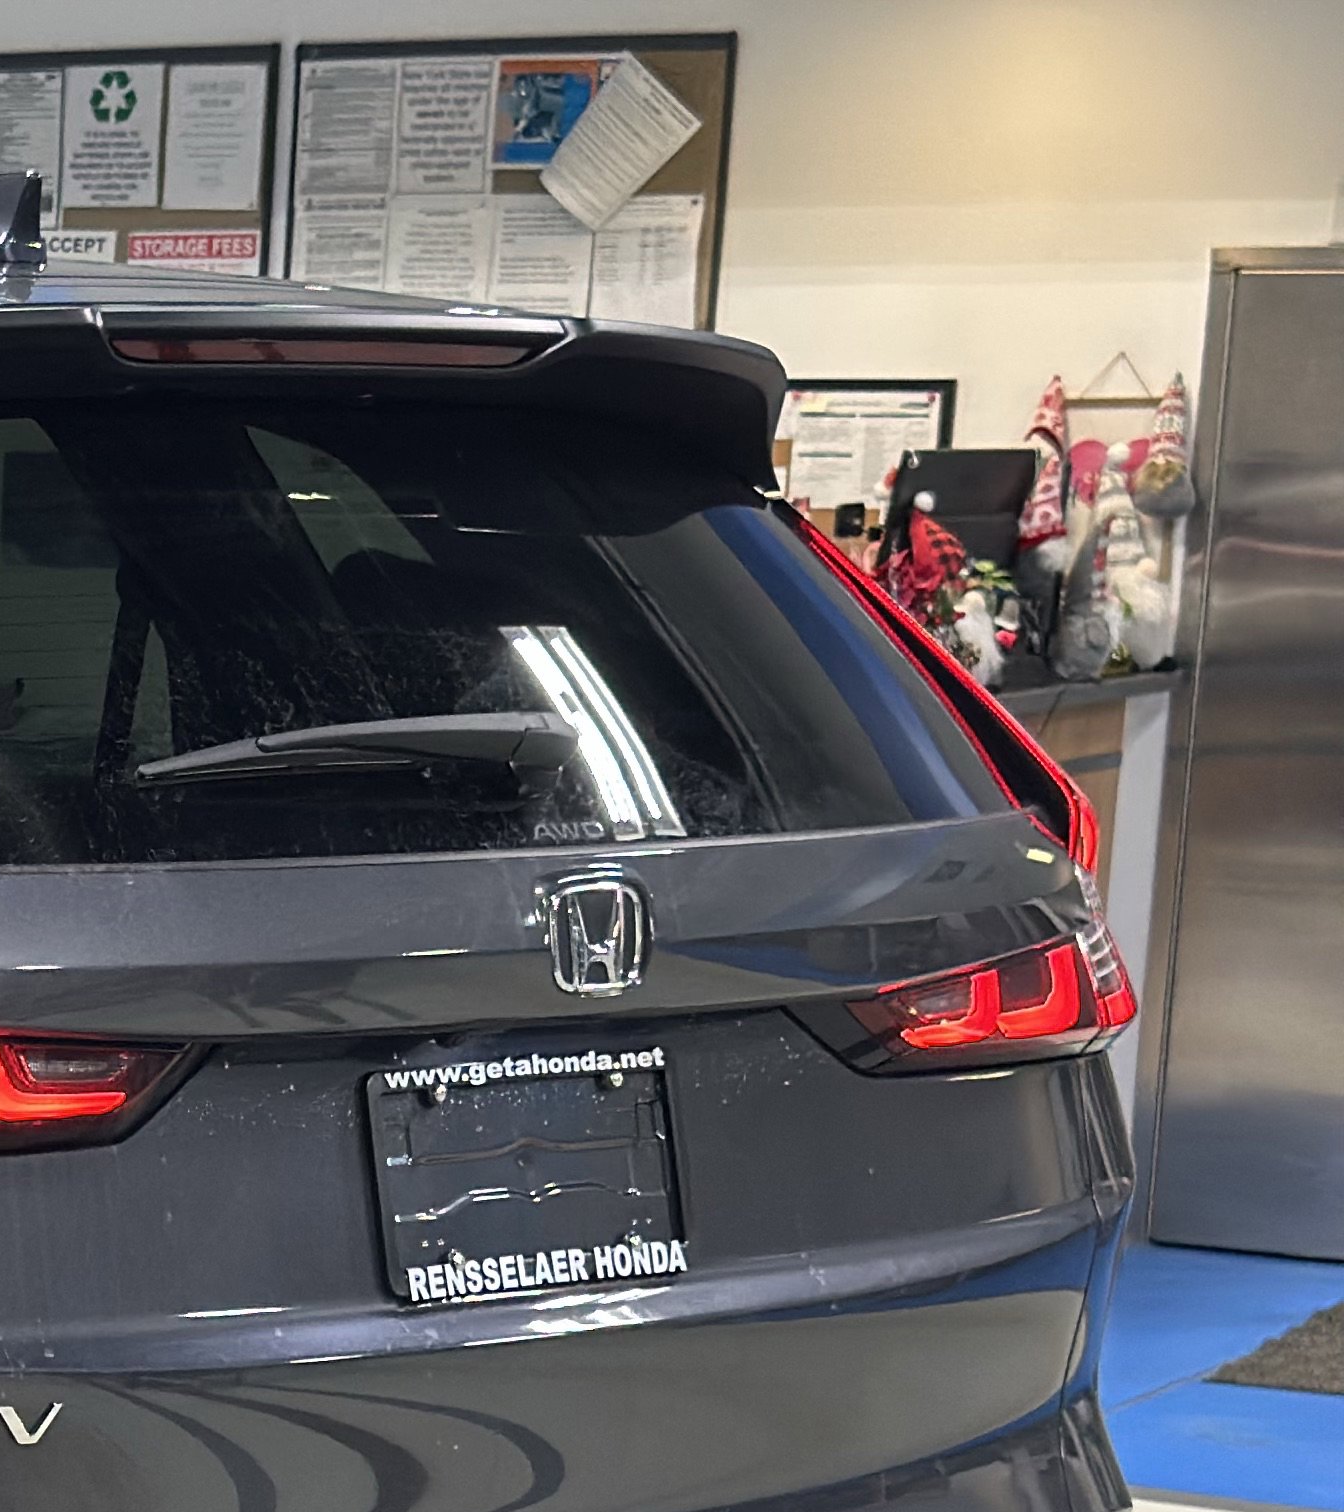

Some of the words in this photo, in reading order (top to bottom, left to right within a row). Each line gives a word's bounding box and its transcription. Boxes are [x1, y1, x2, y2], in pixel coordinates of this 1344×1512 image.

[132, 239, 208, 258] STORAGE
[212, 237, 254, 256] FEES
[533, 820, 605, 842] AWD
[384, 1047, 665, 1089] www.getahonda.net
[408, 1248, 588, 1301] RENSSELAER
[592, 1239, 688, 1280] HONDA
